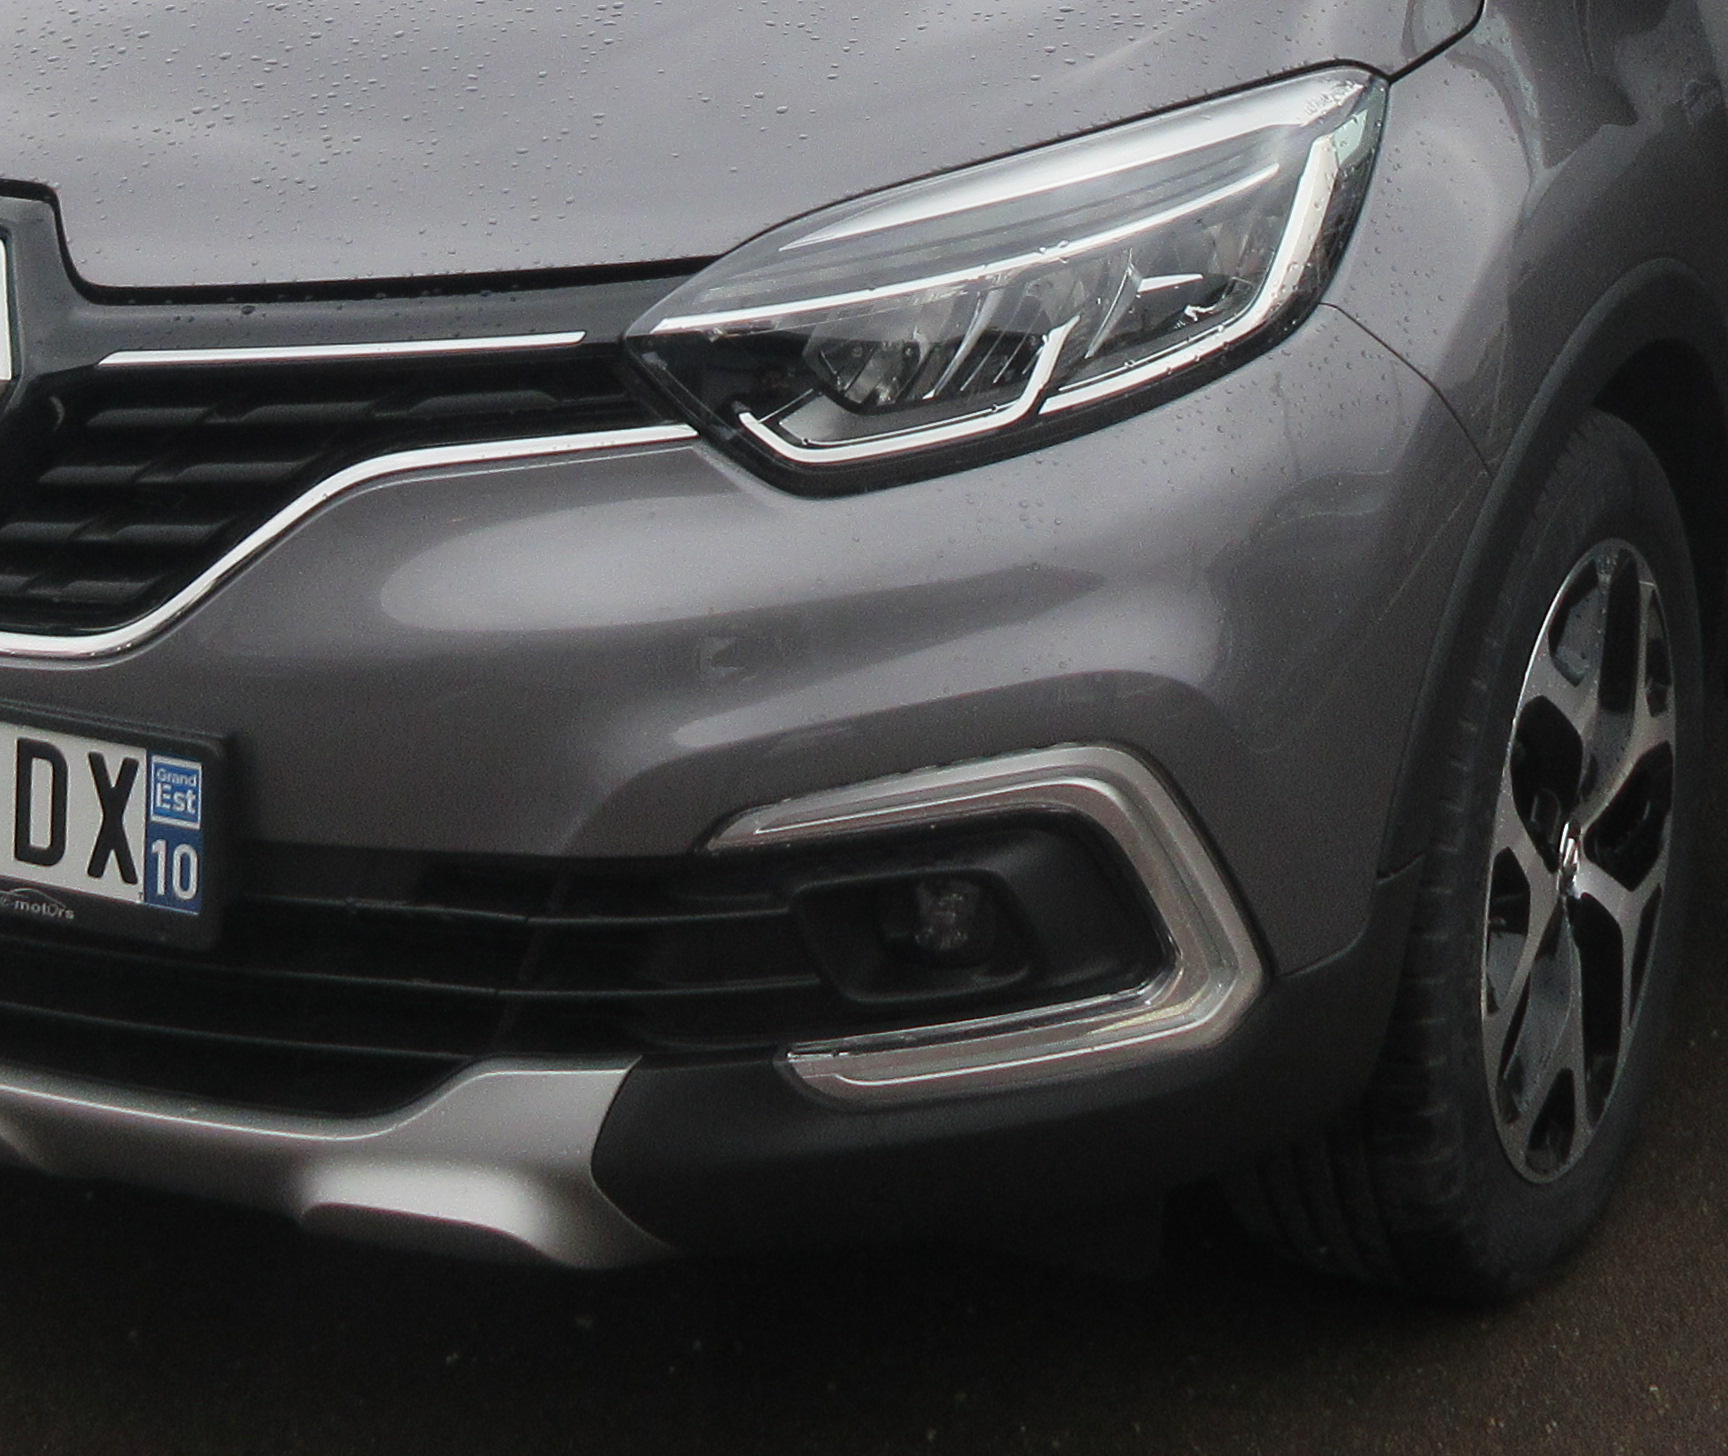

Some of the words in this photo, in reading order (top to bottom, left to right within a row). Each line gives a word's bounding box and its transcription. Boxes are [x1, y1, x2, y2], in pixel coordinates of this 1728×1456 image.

[156, 767, 197, 787] Grand
[155, 782, 196, 815] Est
[151, 839, 198, 900] 10
